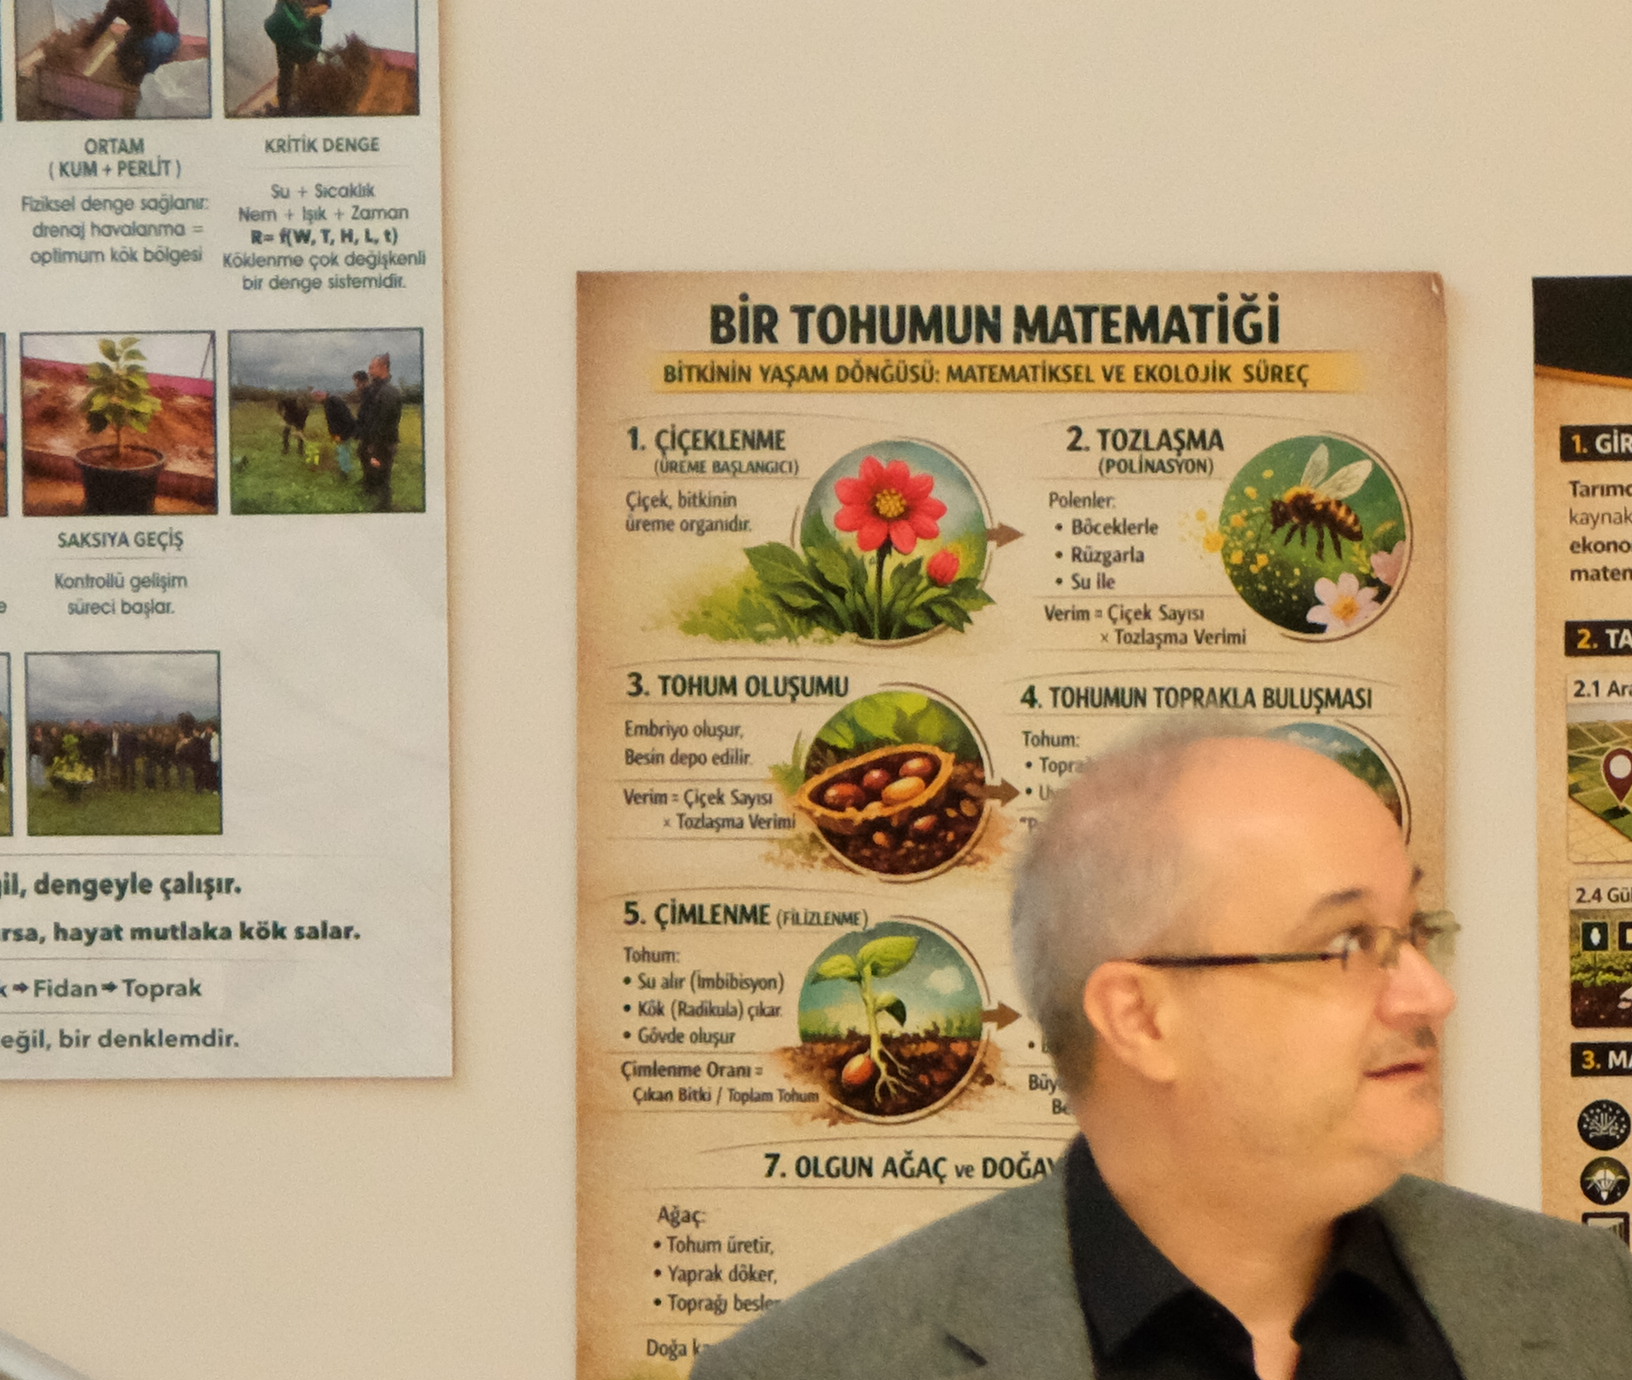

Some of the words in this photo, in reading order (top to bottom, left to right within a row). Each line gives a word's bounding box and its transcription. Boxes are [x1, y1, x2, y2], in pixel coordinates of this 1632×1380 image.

[84, 138, 145, 155] ORTAM
[265, 135, 318, 153] KRİTİK
[323, 137, 379, 153] DENGE
[21, 196, 76, 212] Fiziksel
[80, 195, 135, 216] denge
[30, 248, 105, 267] optimum
[110, 246, 138, 263] kök
[143, 245, 202, 267] bölgesi
[710, 292, 778, 344] BİR
[790, 304, 1001, 345] TOHUMUN
[1013, 292, 1279, 345] MATEMATİĞİ
[664, 360, 751, 383] BİTKİNİN
[759, 365, 828, 389] YAŞAM
[946, 360, 1095, 383] MATEMATİKSEL
[1101, 365, 1125, 383] VE
[1134, 360, 1232, 383] EKOLOJİK
[1243, 359, 1309, 388] SÜREÇ
[627, 426, 646, 450] 1.
[655, 424, 787, 456] ÇİÇEKLENME
[1067, 425, 1090, 451] 2.
[1097, 428, 1224, 456] TOZLAŞMA
[1572, 435, 1587, 453] 1.
[1098, 455, 1214, 477] (POLİNASYON)
[678, 490, 737, 509] bitkinin
[625, 514, 675, 532] üreme
[58, 532, 130, 548] SAKSIYA
[134, 527, 184, 552] GEÇİŞ
[1071, 546, 1144, 568] Rüzgarla
[55, 572, 125, 590] Kontrollü
[129, 572, 188, 593] gelişim
[1071, 573, 1091, 590] Su
[1096, 572, 1115, 590] ile
[68, 599, 116, 615] süreci
[121, 599, 174, 618] başlar.
[1578, 629, 1597, 649] 2.
[627, 672, 649, 697] 3.
[658, 674, 737, 697] TOHUM
[745, 675, 849, 703] OLUŞUMU
[1574, 680, 1599, 698] 2.1
[1020, 685, 1042, 709] 4.
[1049, 686, 1147, 709] TOHUMUN
[1153, 687, 1256, 708] TOPRAKLA
[1263, 687, 1372, 713] BULUŞMASI
[34, 872, 153, 902] dengeyle
[160, 871, 241, 901] çalışır.
[624, 901, 646, 926] 5.
[654, 899, 770, 932] ÇİMLENME
[54, 922, 123, 947] hayat
[130, 921, 232, 941] mutlaka
[240, 921, 287, 940] kök
[294, 920, 360, 940] salar.
[34, 978, 98, 998] Fidan
[122, 978, 202, 1002] Toprak
[59, 1029, 91, 1048] bir
[98, 1028, 239, 1048] denklemdir.
[1582, 1050, 1600, 1069] 3.
[764, 1153, 786, 1178] 7.
[795, 1155, 873, 1179] OLGUN
[882, 1150, 947, 1185] AĞAÇ
[955, 1165, 974, 1178] ve
[666, 1235, 722, 1253] Tohum
[727, 1236, 774, 1255] üretir,
[668, 1264, 723, 1286] Yaprak
[728, 1264, 777, 1284] döker,
[667, 1294, 728, 1316] Toprağı
